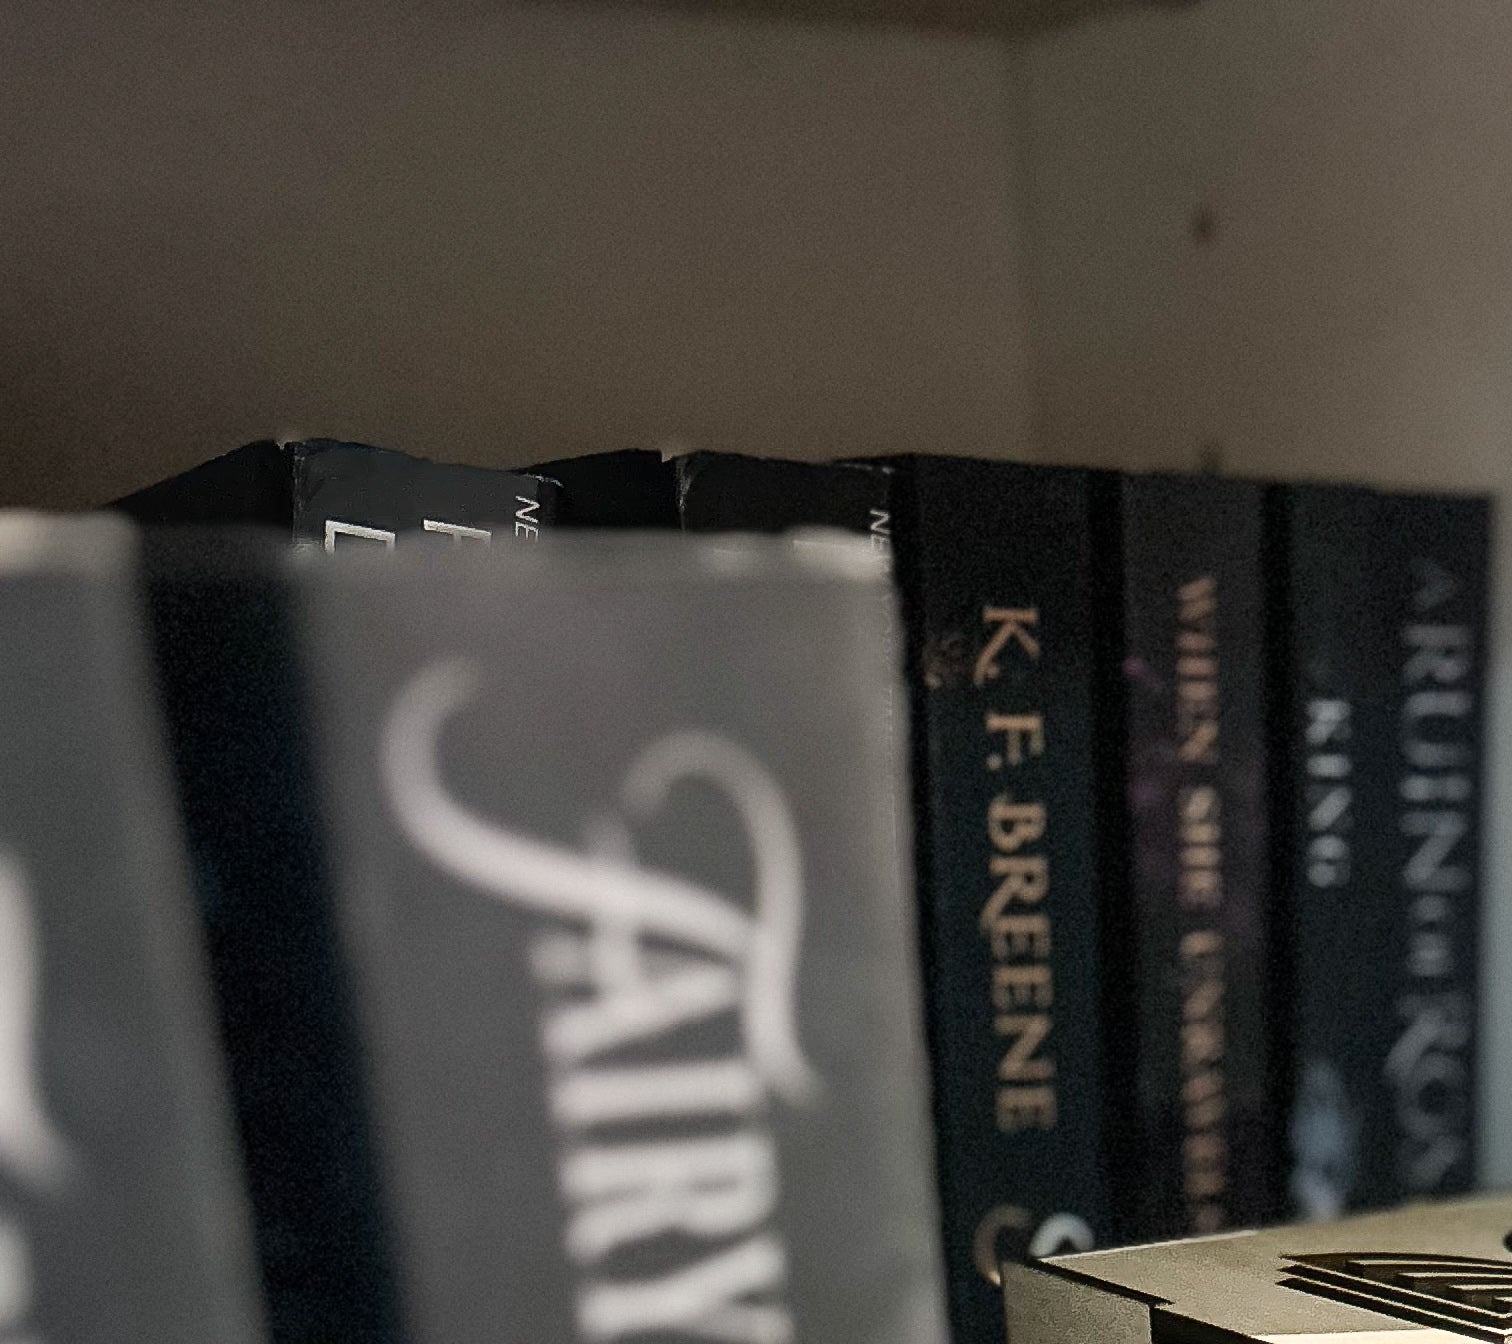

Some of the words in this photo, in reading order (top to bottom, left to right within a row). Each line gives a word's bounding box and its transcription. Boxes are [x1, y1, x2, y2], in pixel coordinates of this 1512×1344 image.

[514, 494, 542, 545] NE
[984, 713, 1046, 772] F.
[1305, 696, 1352, 888] KING
[1402, 622, 1474, 892] RUIN
[978, 798, 1058, 1134] BREENE
